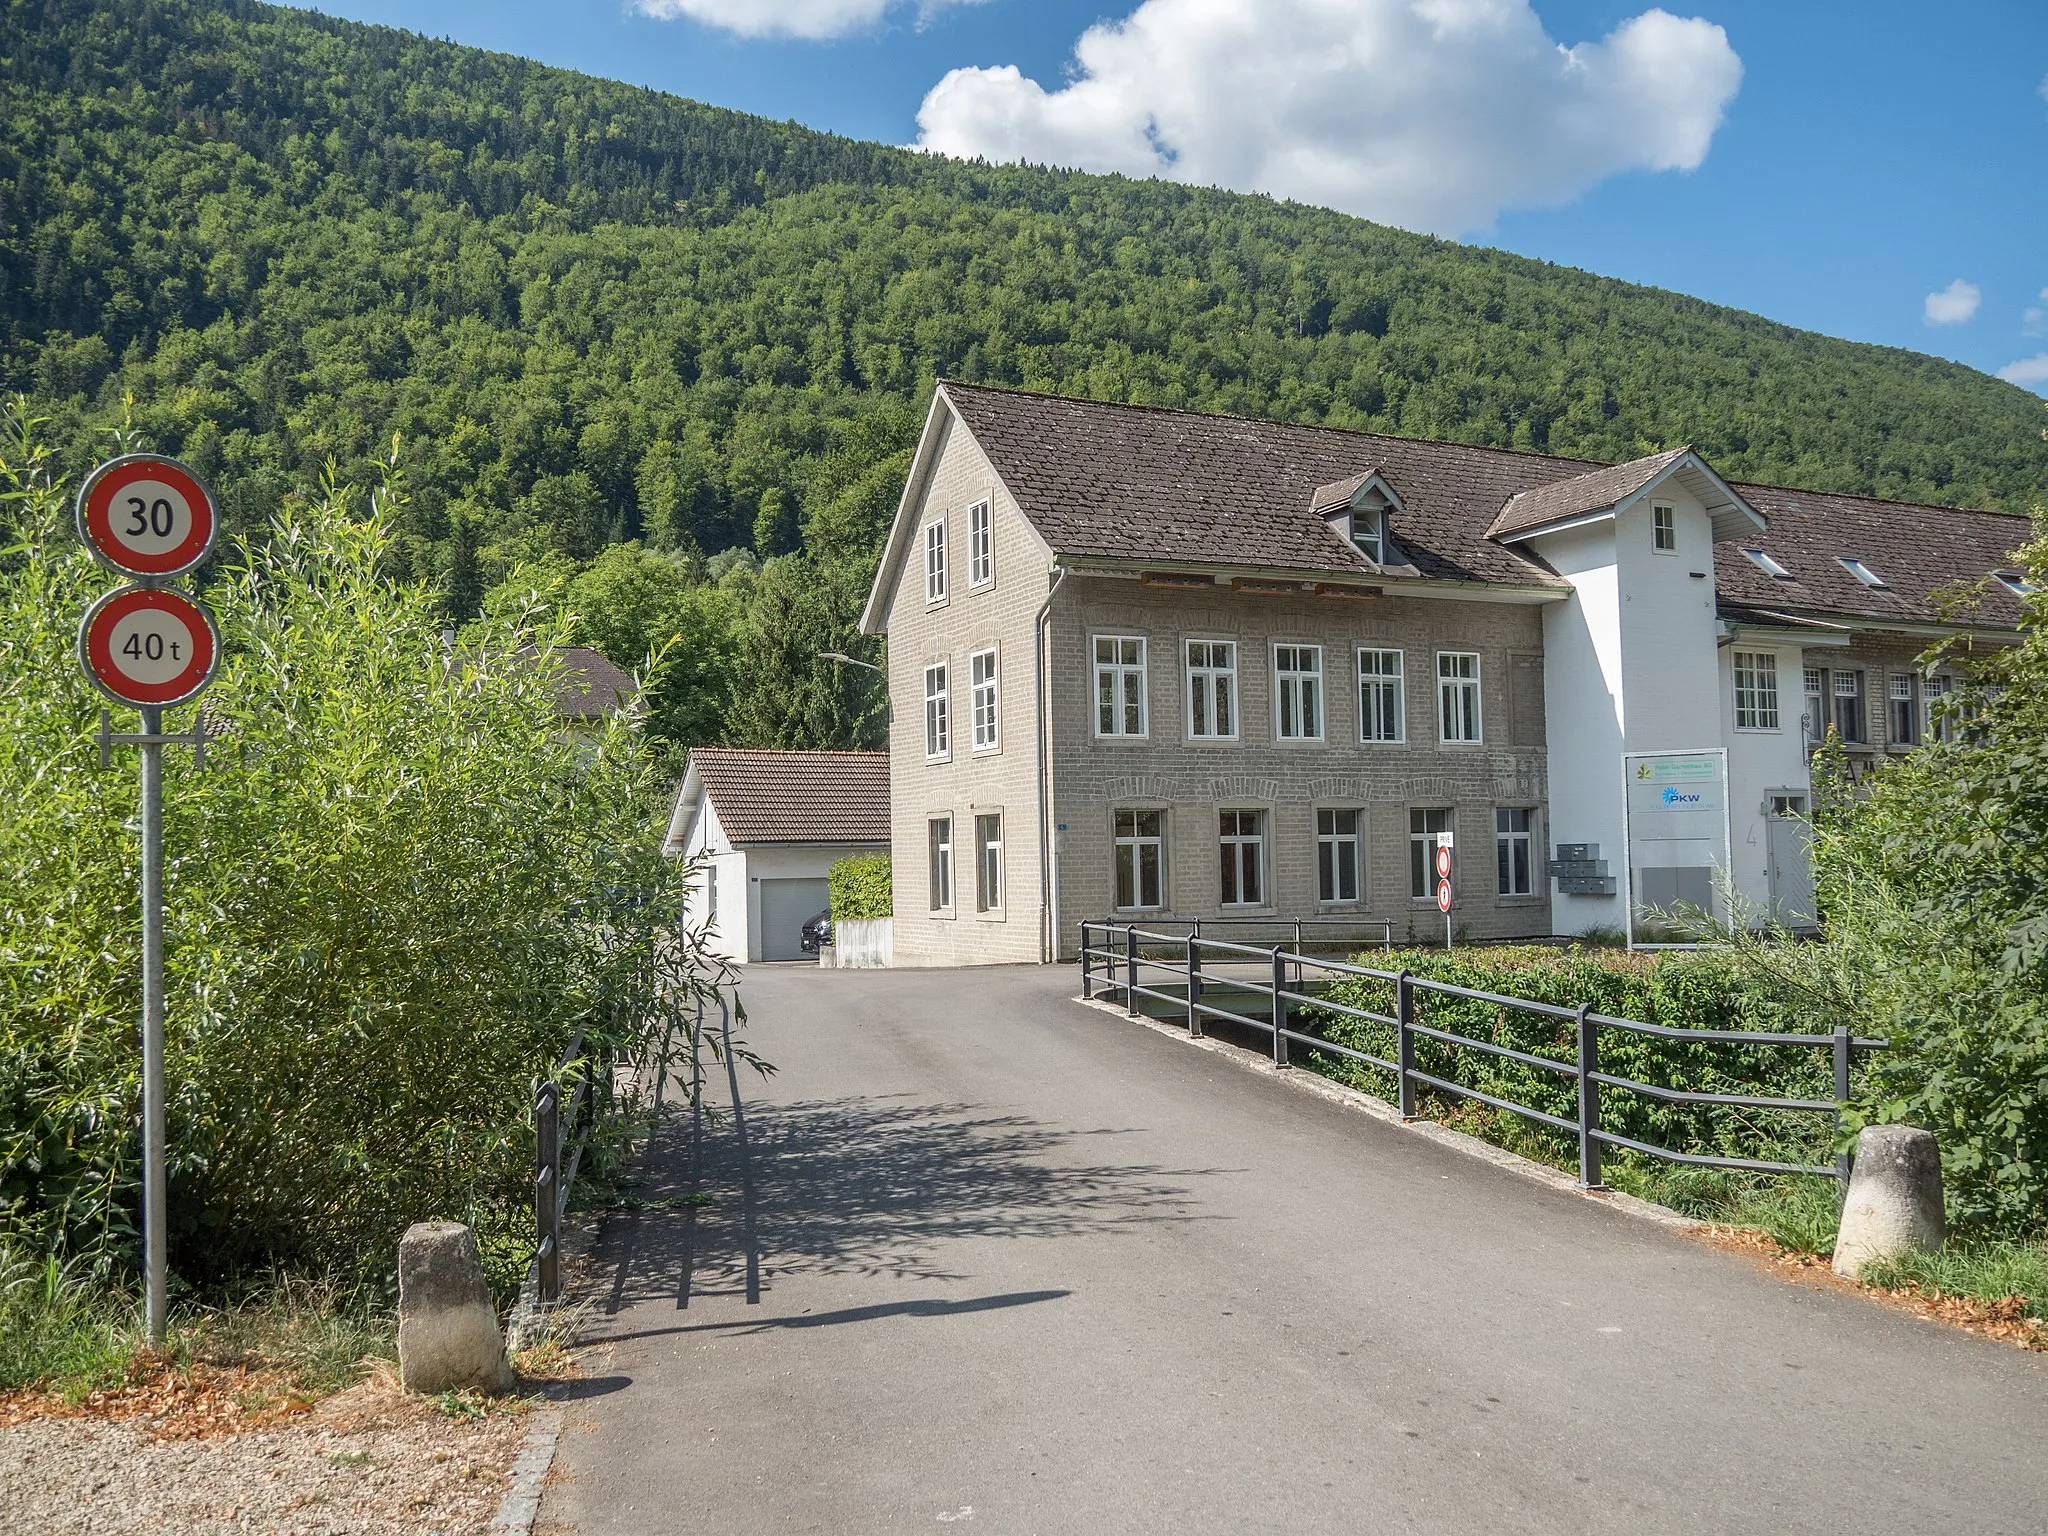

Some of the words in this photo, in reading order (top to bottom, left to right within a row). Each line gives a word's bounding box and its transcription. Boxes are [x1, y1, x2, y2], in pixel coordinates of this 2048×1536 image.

[125, 497, 174, 537] 30
[122, 633, 164, 661] 40
[170, 641, 181, 661] t
[1670, 794, 1700, 802] PKW
[1746, 823, 1757, 847] 4
